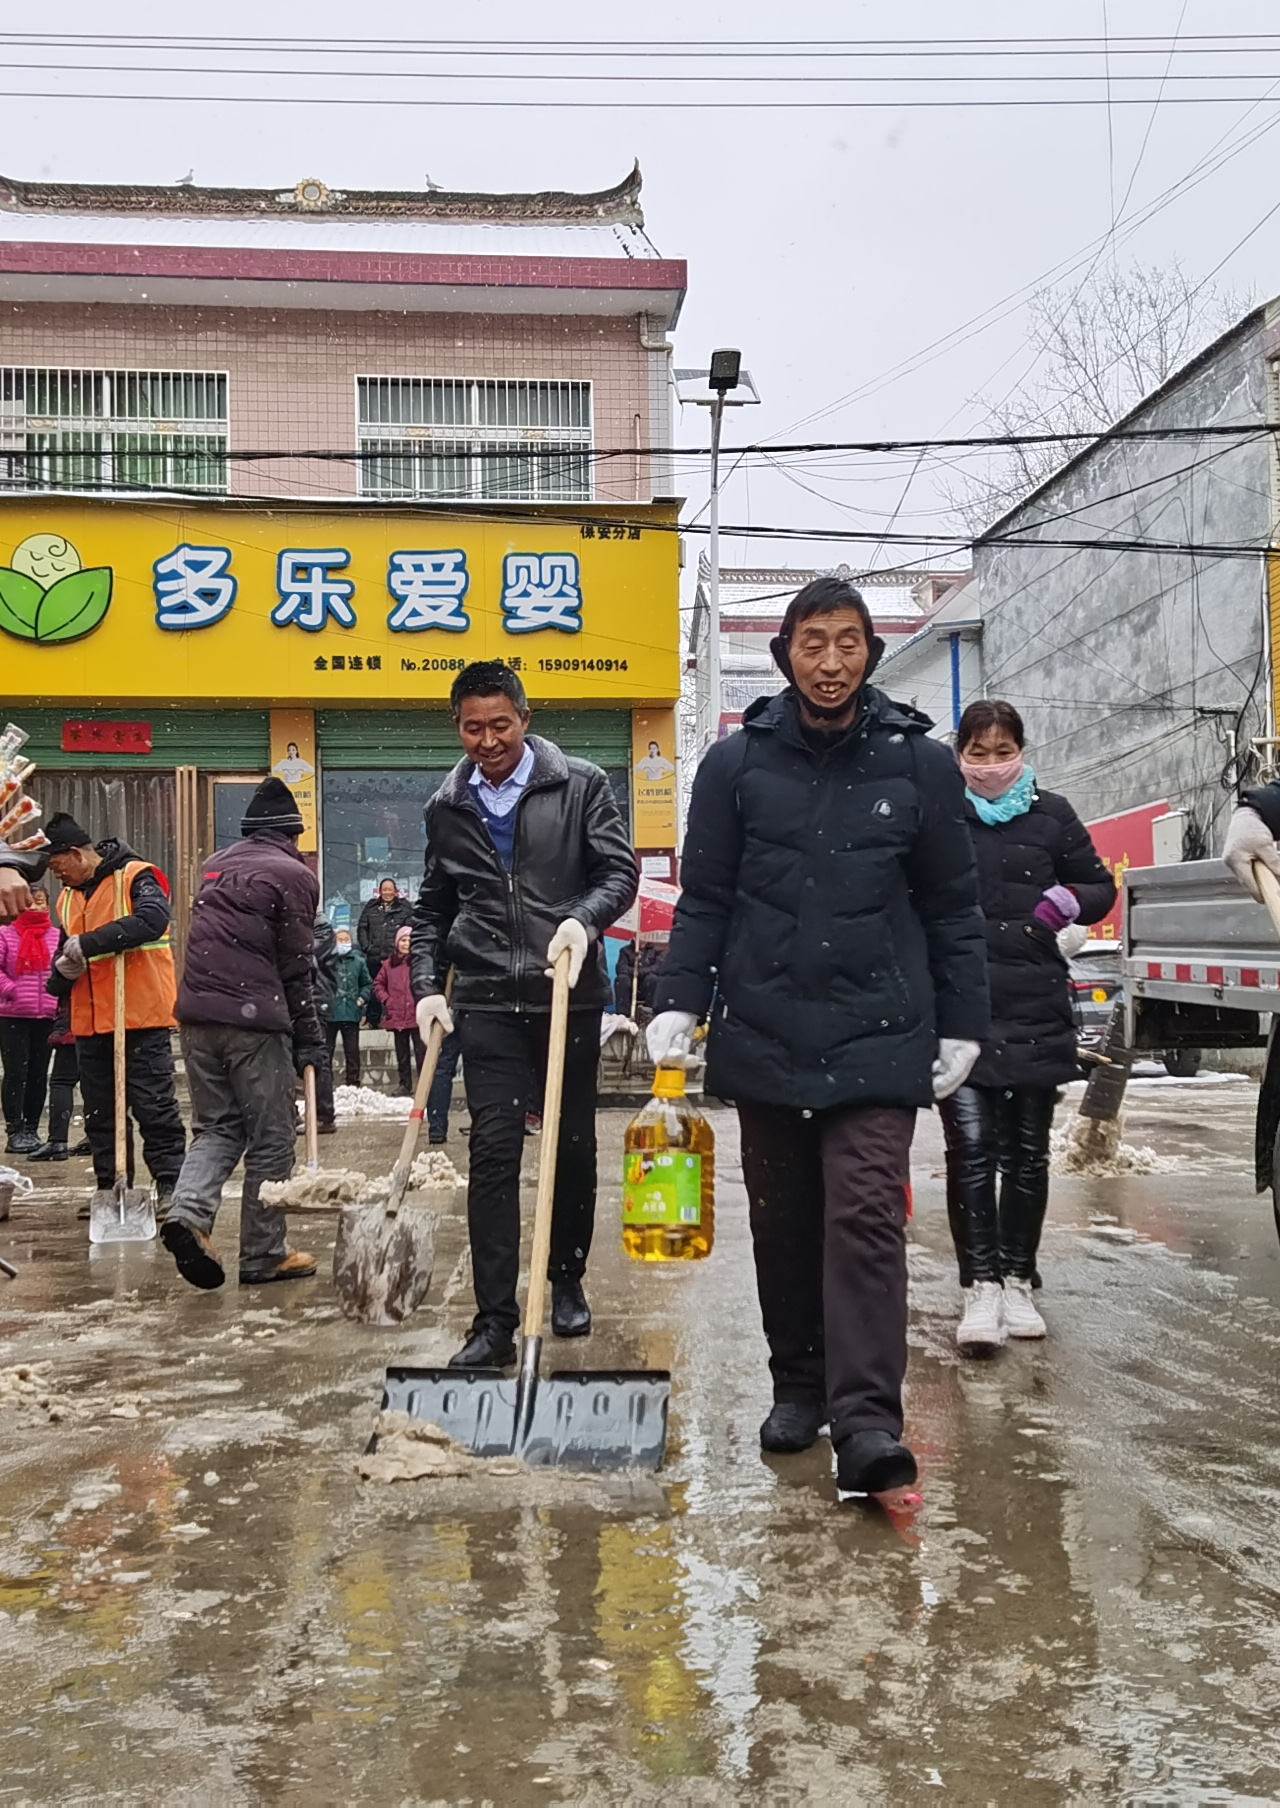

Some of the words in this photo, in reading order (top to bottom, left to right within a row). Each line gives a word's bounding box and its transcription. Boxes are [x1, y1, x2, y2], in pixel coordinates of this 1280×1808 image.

[580, 525, 641, 540] 保安分店
[152, 542, 583, 634] 多乐爱婴
[314, 656, 382, 671] 全国连锁
[401, 657, 466, 672] No.20088
[537, 657, 629, 672] 15909140914
